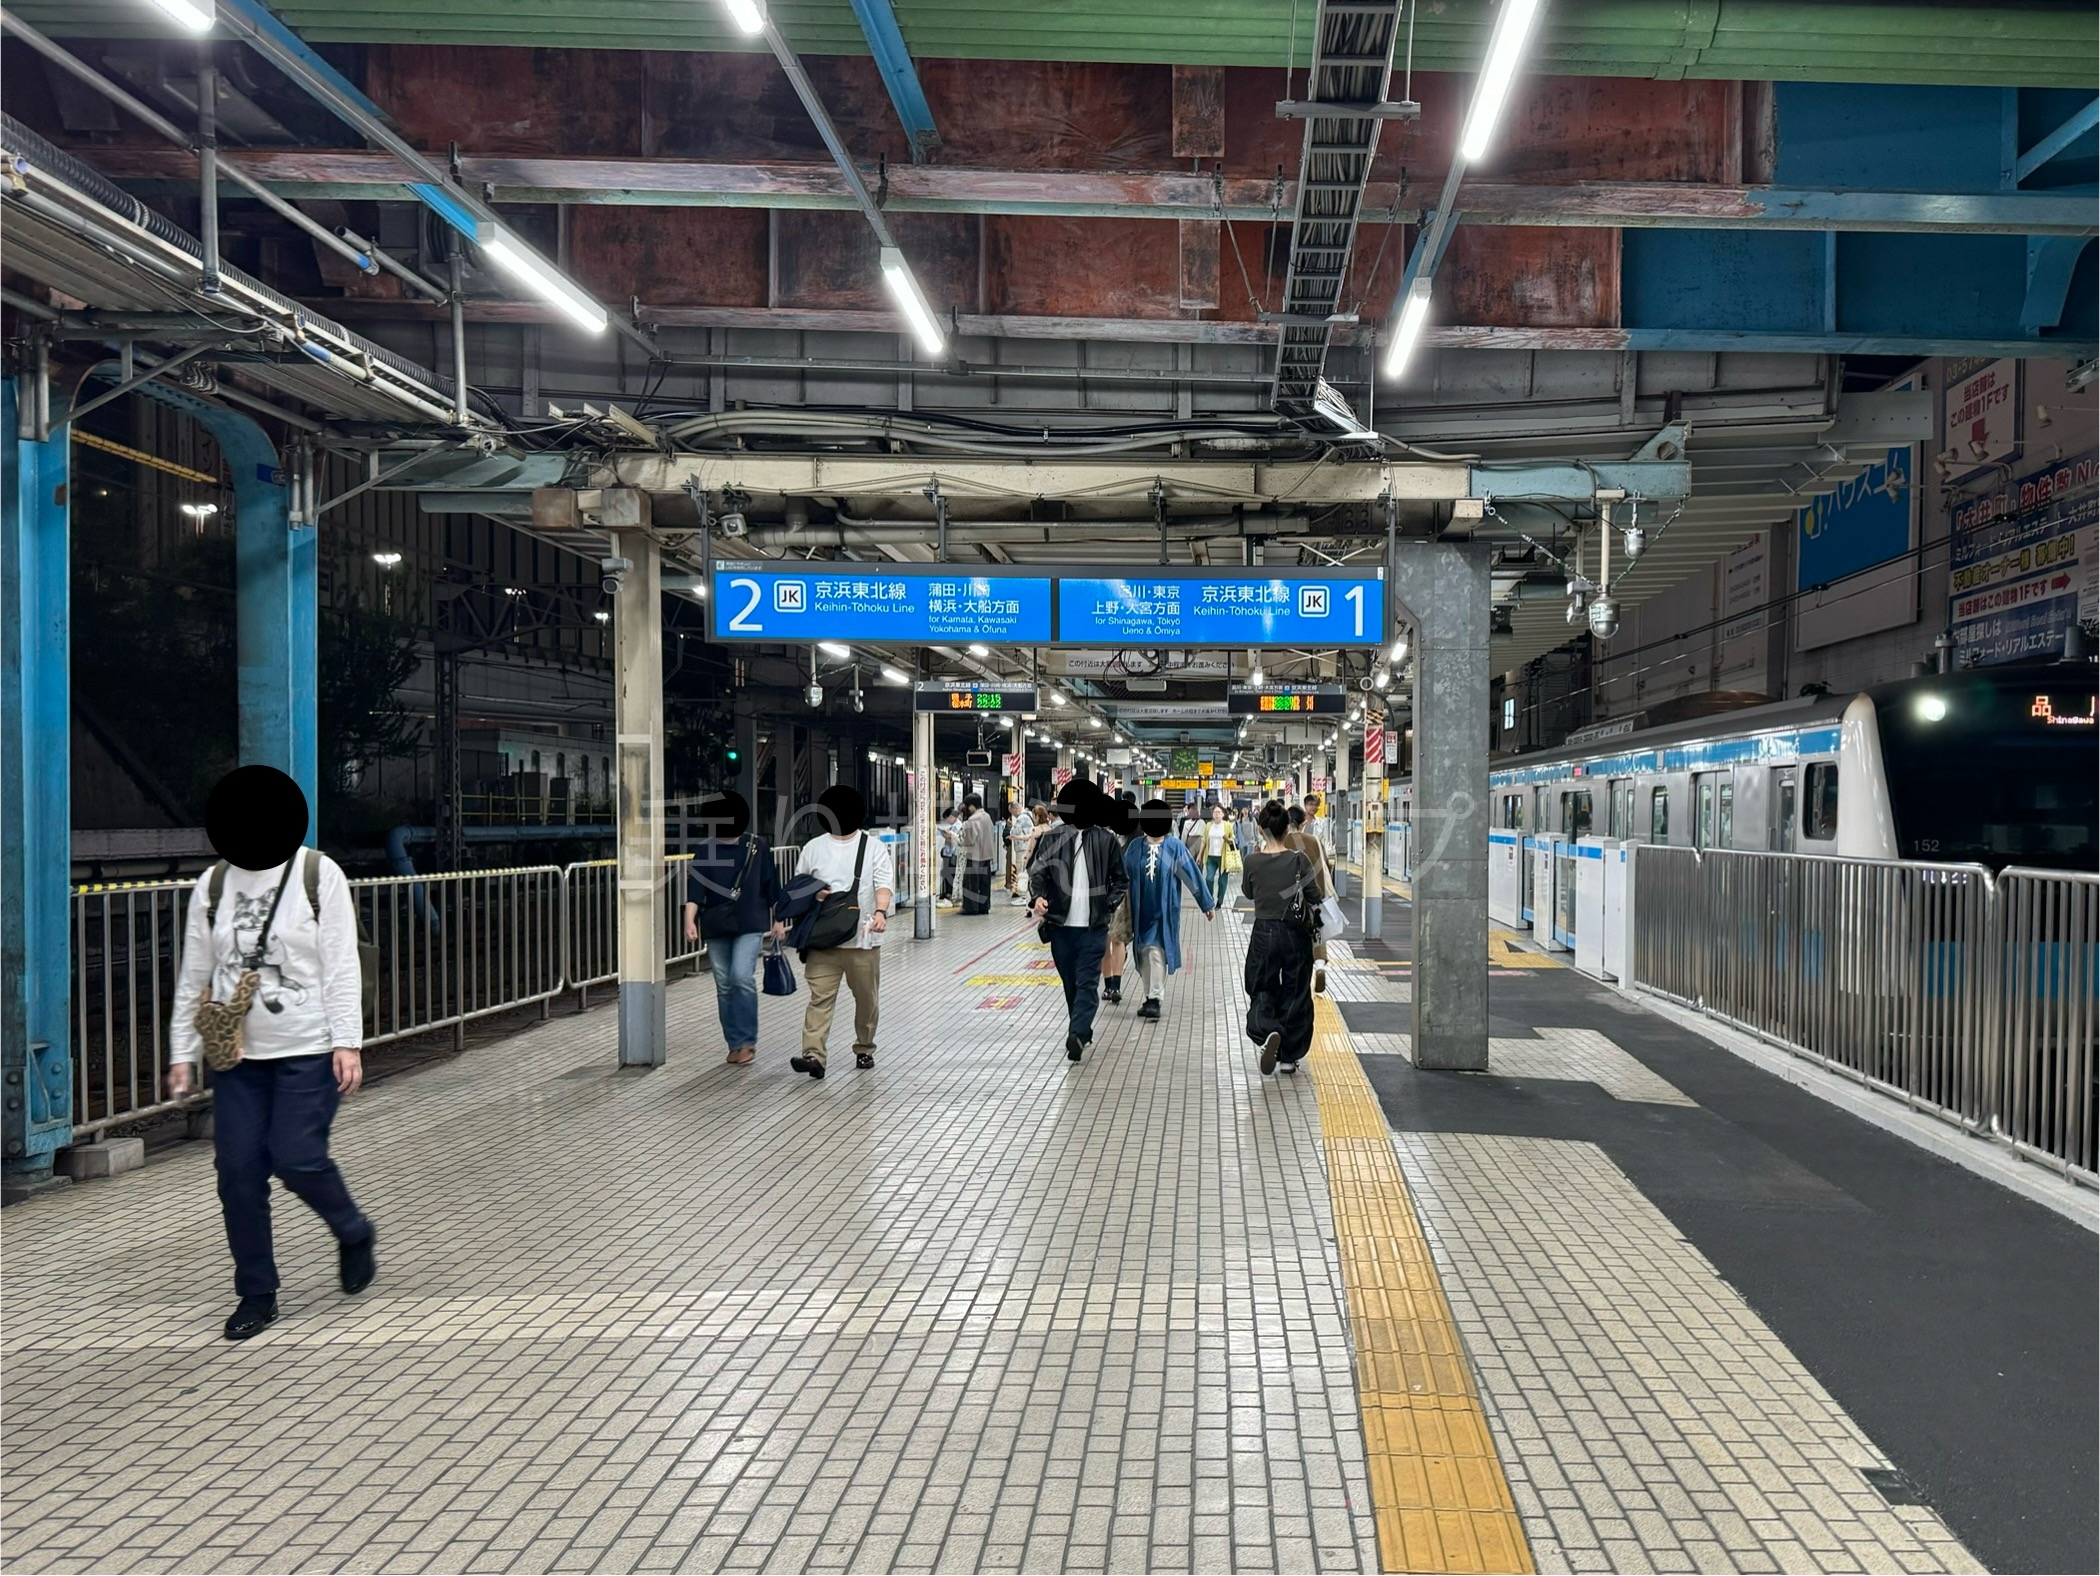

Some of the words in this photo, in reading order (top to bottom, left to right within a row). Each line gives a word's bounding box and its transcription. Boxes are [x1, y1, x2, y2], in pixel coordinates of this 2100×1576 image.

[781, 590, 799, 603] JK
[814, 581, 907, 600] 京浜東北線
[1201, 585, 1290, 604] 京浜東北線
[729, 578, 763, 632] 2
[928, 599, 1019, 614] 横浜・大船方面
[1091, 600, 1180, 615] 上野・大宮方面
[1305, 595, 1323, 608] JK
[892, 602, 915, 614] Line
[1269, 605, 1290, 616] Line
[1344, 585, 1364, 637] 1
[928, 615, 940, 624] for
[978, 615, 1017, 624] Kawasaki
[1095, 617, 1106, 625] for
[929, 624, 972, 633] Yokohama
[973, 625, 980, 633] &
[1122, 626, 1144, 635] Ueno
[1146, 626, 1152, 635] &
[917, 681, 925, 691] 2
[1338, 685, 1343, 694] 1
[2047, 715, 2095, 725] Shinagawa
[1912, 839, 1940, 852] 152
